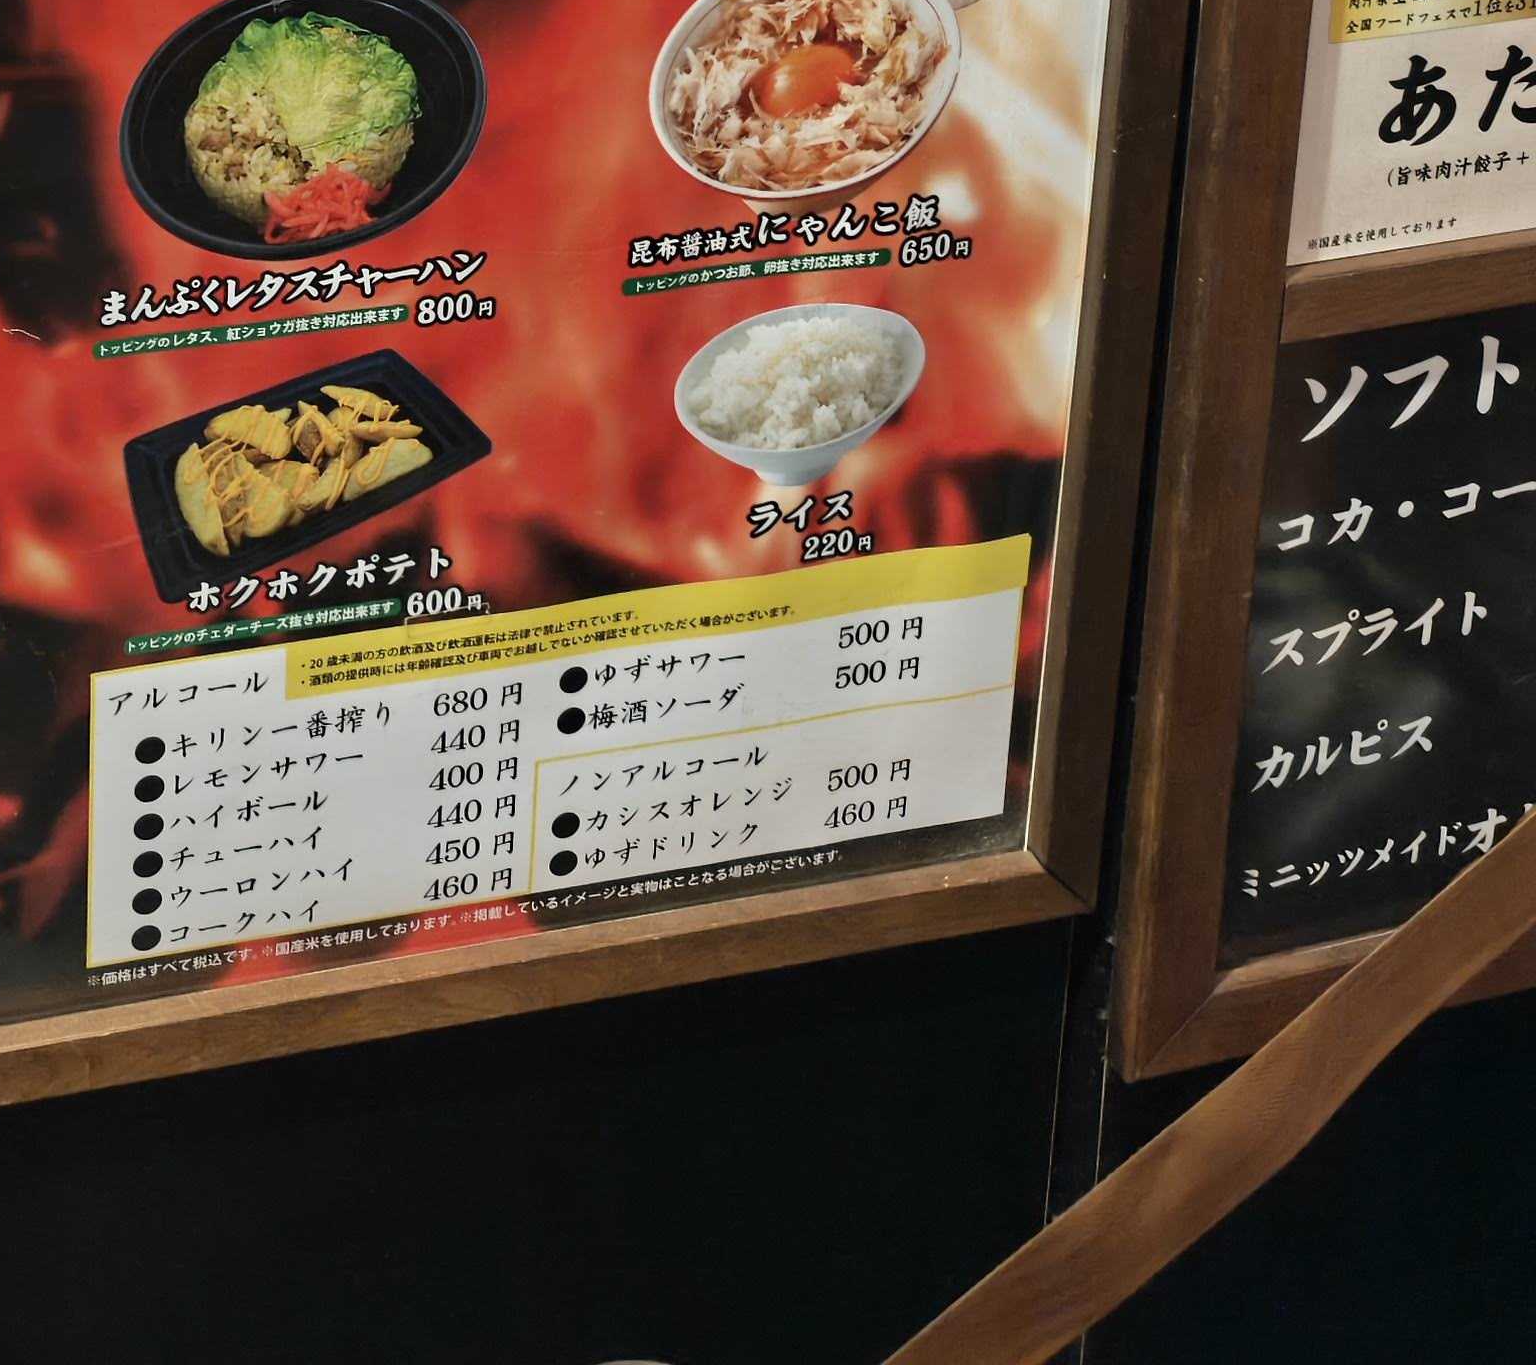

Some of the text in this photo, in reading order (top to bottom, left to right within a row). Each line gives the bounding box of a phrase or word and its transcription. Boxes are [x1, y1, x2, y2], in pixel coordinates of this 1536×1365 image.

[631, 198, 941, 265] 昆布醤油式にゃんこ飯
[902, 235, 970, 264] 650円
[101, 253, 485, 326] まんぷくレタスチャーハン
[418, 294, 493, 324] 800円
[1300, 335, 1520, 442] ソフト
[750, 493, 851, 535] ライス
[803, 530, 871, 560] 220円
[189, 548, 451, 612] ホクホクポテト
[406, 587, 482, 616] 600円
[594, 616, 924, 686] ゆずサワー 500円
[1262, 592, 1488, 676] スプライト
[108, 671, 270, 717] アルコール
[171, 682, 523, 758] キリン一番搾り 680円
[589, 657, 920, 730] 梅酒ソーダ 500円
[174, 719, 521, 795] レモンサワー 440円
[560, 746, 769, 796] ノンアルコール
[1250, 716, 1434, 794] カルピス
[170, 757, 519, 830] ハイボール 400円
[586, 759, 911, 831] カシスオレンジ 500円
[170, 794, 517, 872] チューハイ 440円
[584, 796, 908, 869] ゆずドリンク 460円
[1242, 803, 1533, 897] ミニッツメイドオ
[170, 831, 514, 908] ウーロンハイ 450円
[170, 868, 513, 943] コークハイ 460円
